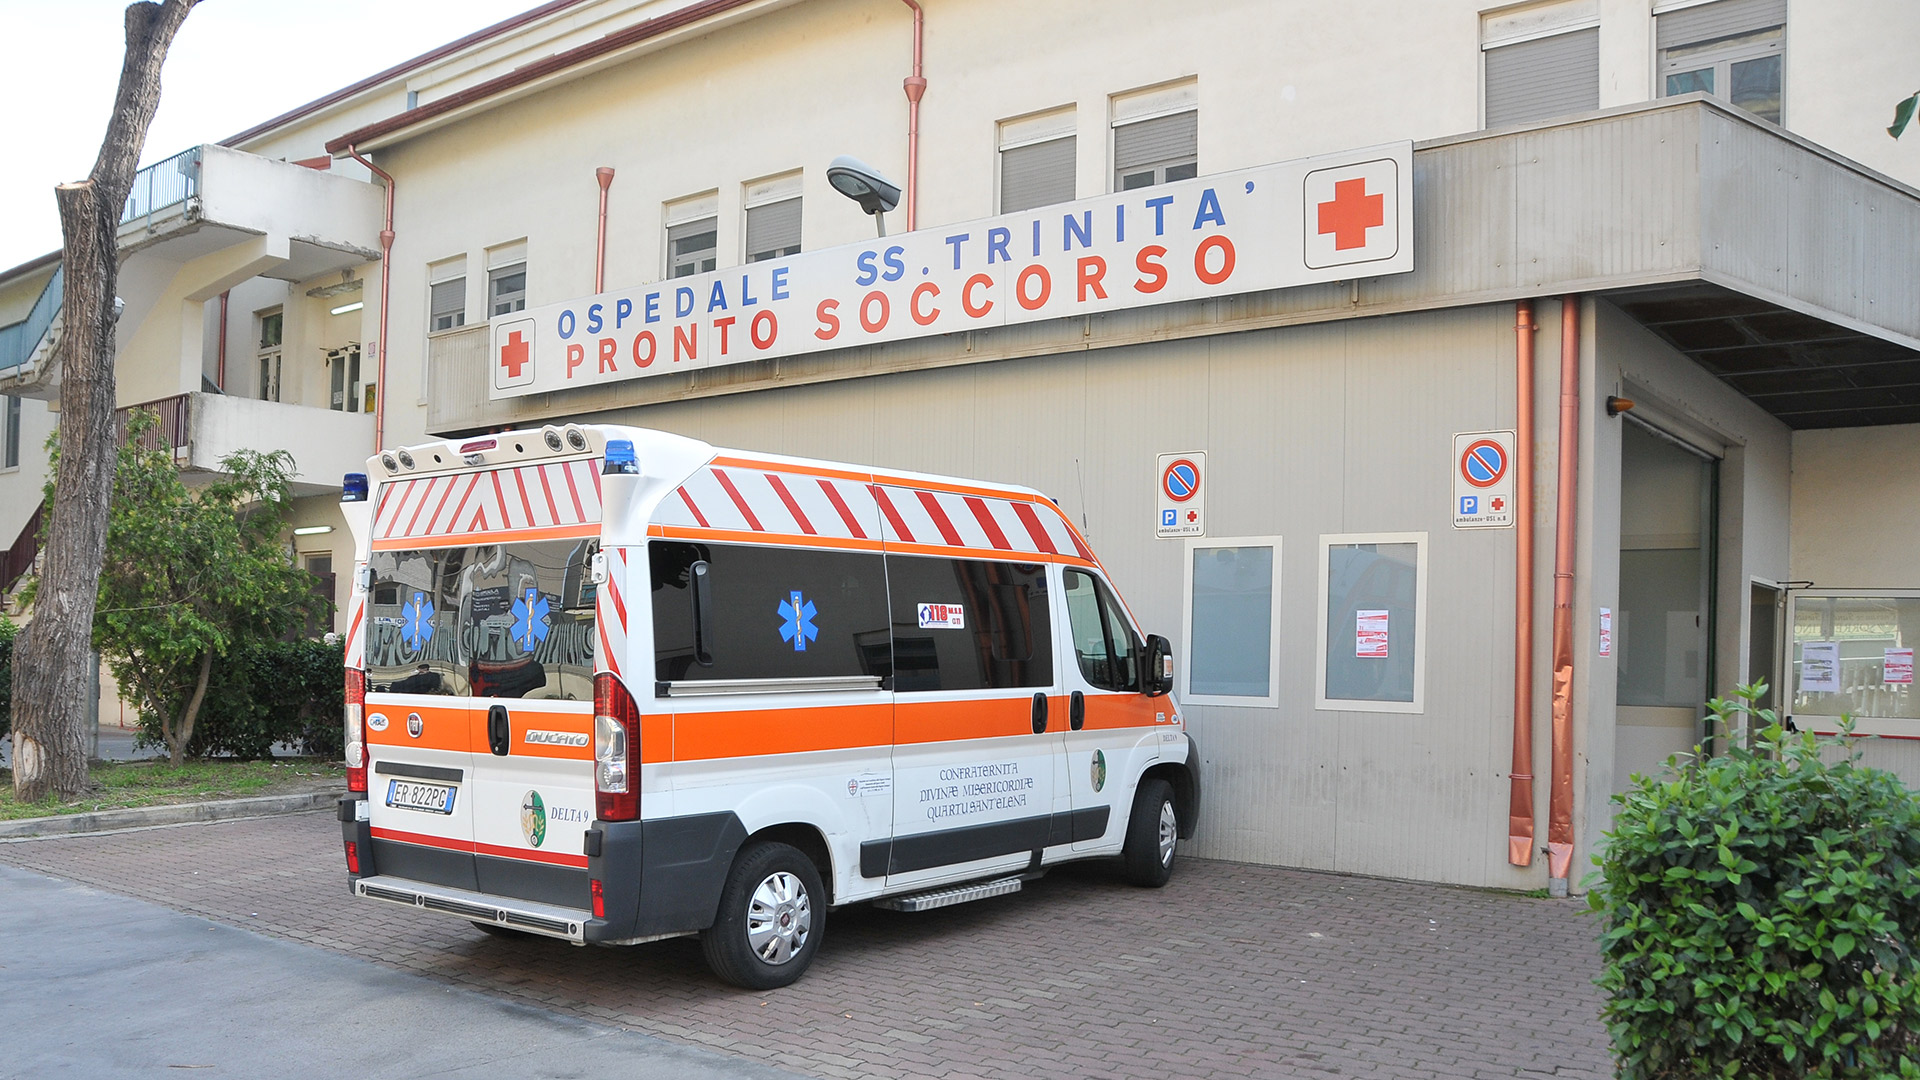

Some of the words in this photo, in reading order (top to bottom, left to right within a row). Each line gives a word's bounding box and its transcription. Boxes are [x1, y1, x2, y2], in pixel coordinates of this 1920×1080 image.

[558, 267, 791, 339] OSPEDALE
[567, 309, 779, 379] PRONTO
[815, 235, 1236, 341] SOCCORSO
[929, 605, 948, 621] 118
[525, 732, 588, 745] DUCATO
[939, 762, 1019, 781] CONFRATERNITA
[551, 807, 581, 822] DELTA
[583, 810, 589, 823] 9
